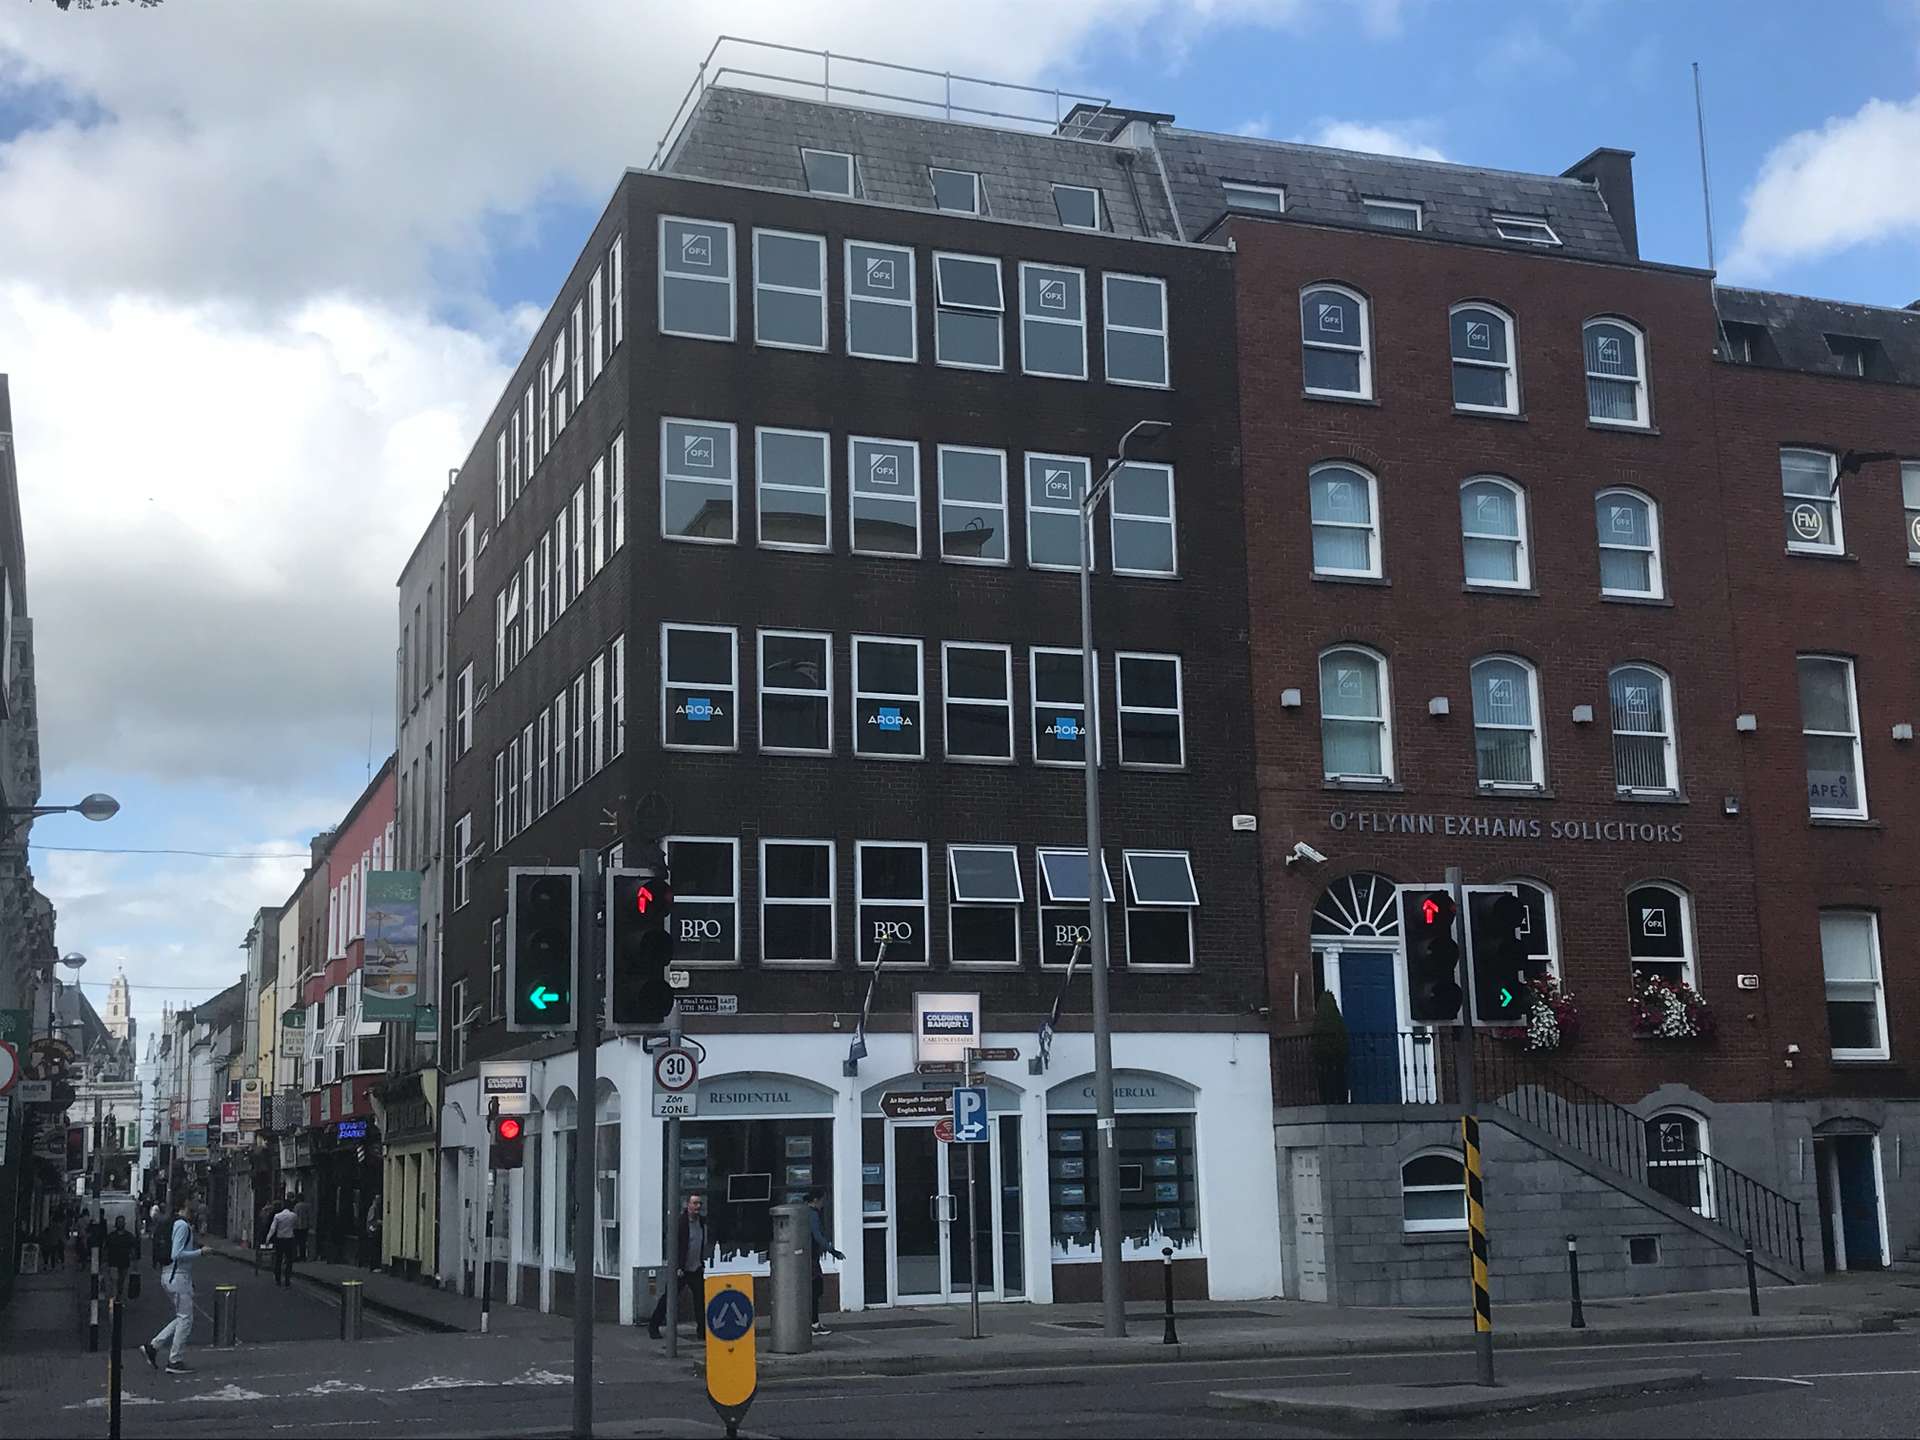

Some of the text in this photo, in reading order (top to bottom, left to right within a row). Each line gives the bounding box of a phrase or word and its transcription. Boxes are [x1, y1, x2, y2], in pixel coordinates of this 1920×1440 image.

[688, 247, 707, 256] OFX
[872, 271, 890, 280] OFX
[1045, 292, 1062, 301] OFX
[1324, 316, 1340, 324] OFX
[1472, 333, 1487, 341] OFX
[690, 449, 709, 458] OFX
[877, 467, 895, 475] OFX
[1050, 482, 1068, 490] OFX
[1797, 512, 1817, 528] FM
[675, 705, 724, 716] ARORA
[867, 715, 913, 726] ARORA
[1045, 725, 1086, 735] ARORA
[1811, 784, 1848, 798] APEX
[1330, 811, 1683, 842] O'FLYNN EXHAMS SOLICITORS
[680, 919, 721, 938] BPO
[873, 921, 912, 940] BPO
[1055, 925, 1091, 943] BPO
[667, 1058, 685, 1075] 30
[710, 1092, 791, 1103] RESIDENTIAL
[1083, 1088, 1158, 1097] COERCIAL
[666, 1095, 683, 1103] Zón
[897, 1106, 918, 1114] English
[959, 1091, 981, 1125] P
